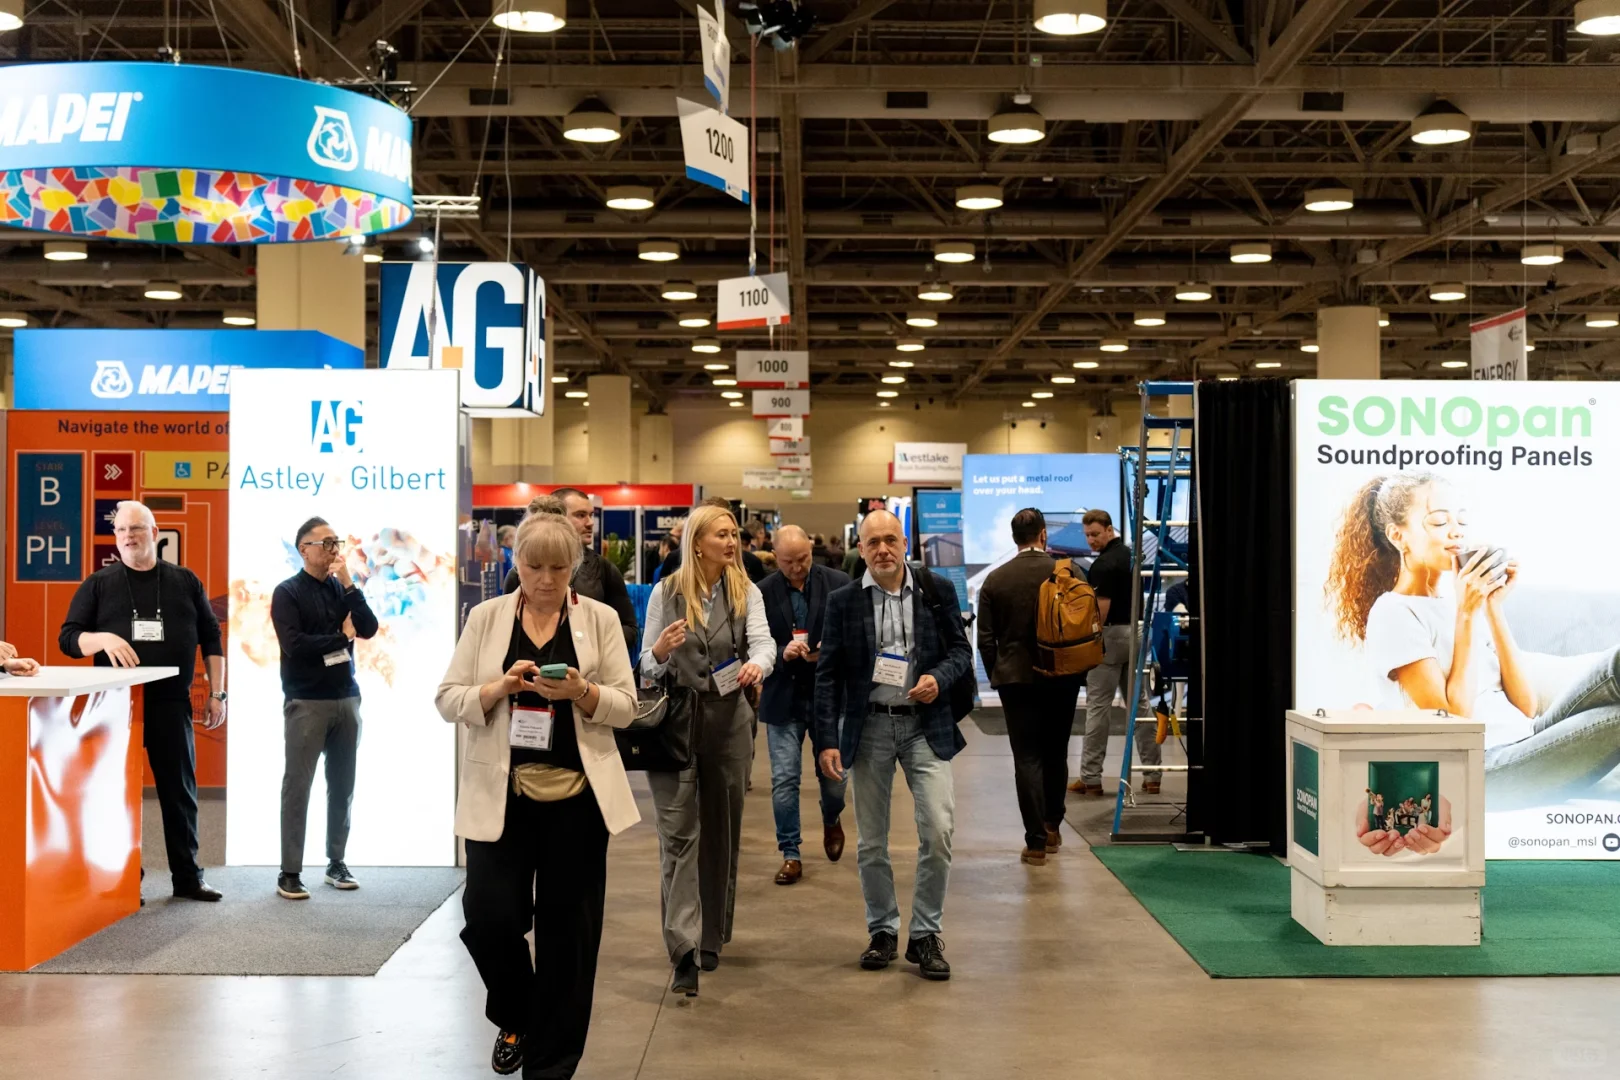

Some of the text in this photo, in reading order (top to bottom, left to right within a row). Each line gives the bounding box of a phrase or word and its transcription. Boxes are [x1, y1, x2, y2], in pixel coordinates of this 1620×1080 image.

[706, 128, 734, 163] 1200
[740, 288, 769, 307] 1100
[386, 262, 524, 408] AG
[524, 267, 546, 415] AG
[757, 360, 789, 373] 1000
[138, 365, 236, 394] MAPE
[771, 397, 791, 408] 900
[58, 419, 229, 436] Navigate the world of
[1317, 444, 1593, 471] Soundproofing Panels
[240, 465, 446, 496] Astley Gilbert
[973, 474, 1073, 485] Let us put a metal roof
[973, 485, 1044, 496] over your head.
[41, 477, 61, 506] B
[26, 536, 71, 565] PH
[1546, 813, 1620, 824] SONOPAN.
[1508, 836, 1597, 848] @sonopan_msl
